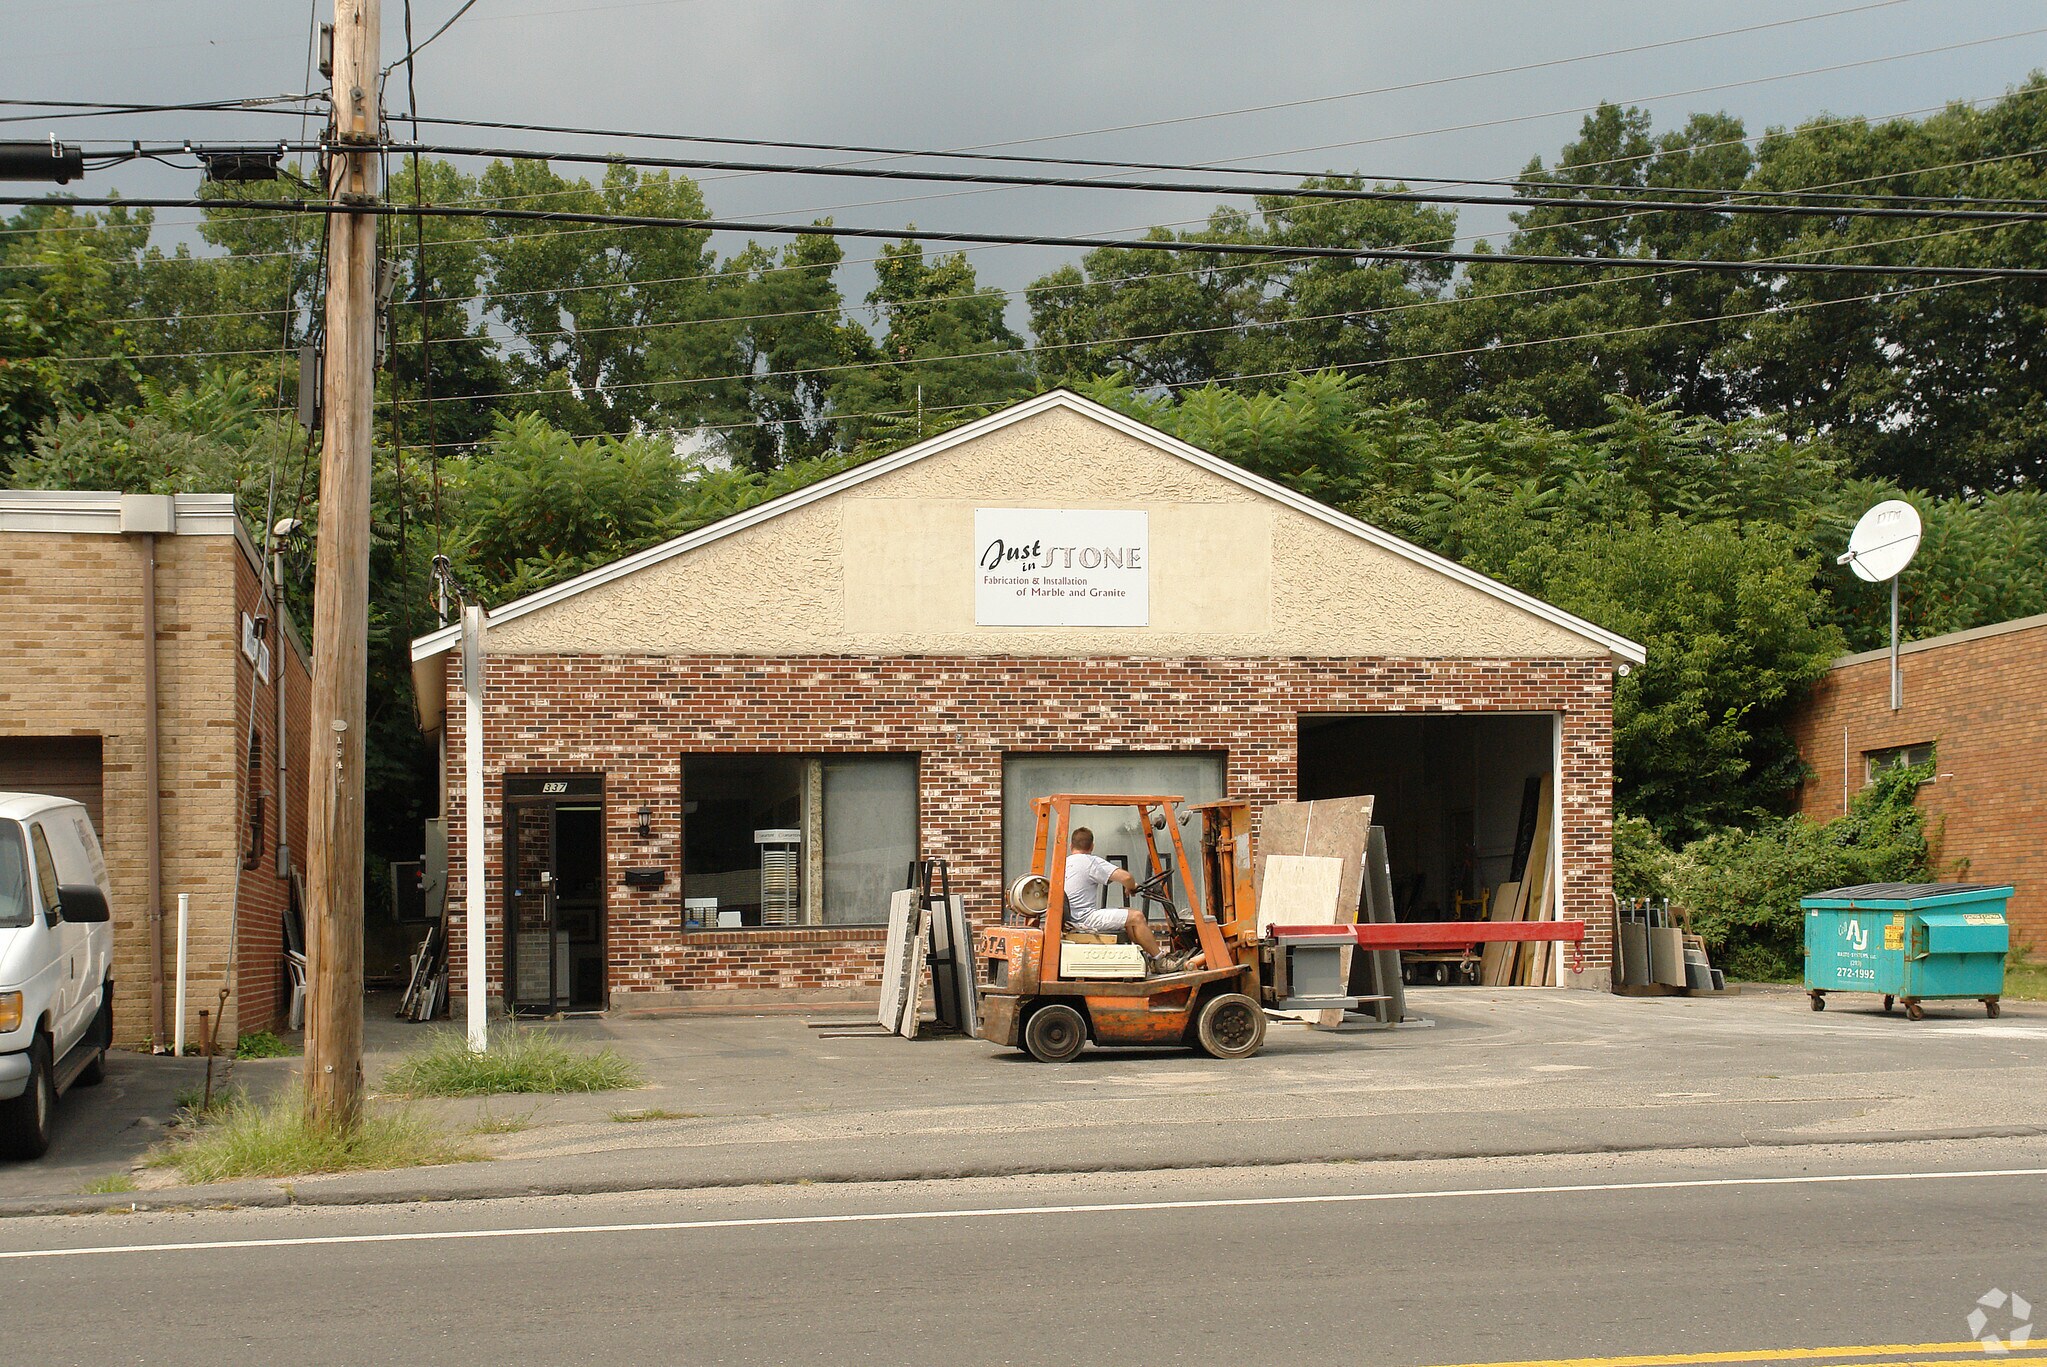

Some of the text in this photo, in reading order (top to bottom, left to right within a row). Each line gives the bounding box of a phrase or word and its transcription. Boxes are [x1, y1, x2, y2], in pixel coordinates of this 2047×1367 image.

[980, 539, 1041, 570] Just
[1041, 547, 1142, 569] STONE
[1022, 562, 1036, 572] in
[984, 576, 1088, 586] Fabrication & Installation
[1016, 588, 1126, 597] of Marble and Granite
[545, 783, 566, 791] 337
[1846, 919, 1868, 950] AJ
[1083, 950, 1132, 960] TOYOTA
[1836, 966, 1875, 980] 272-1992
